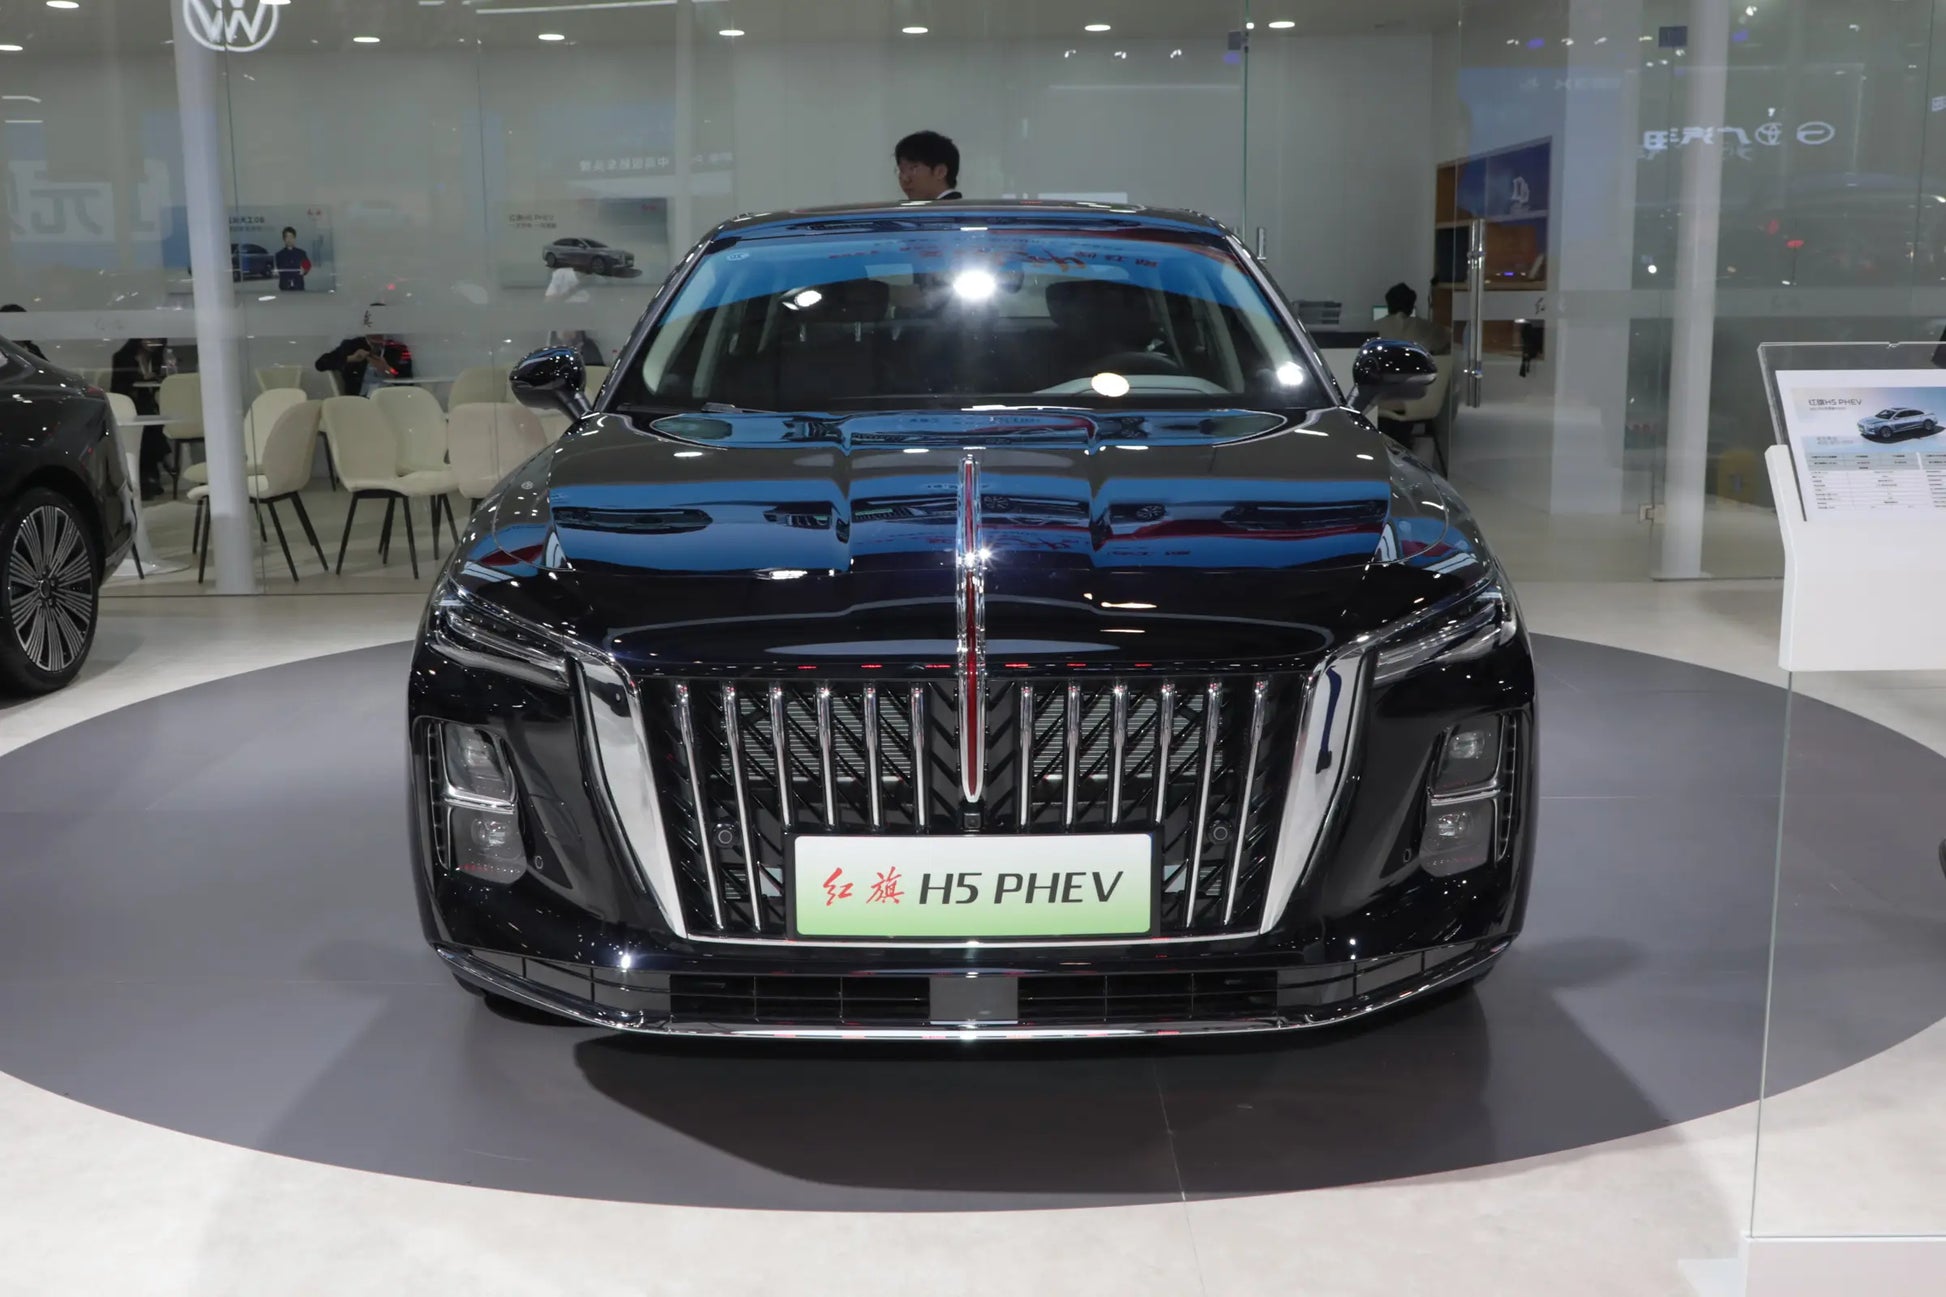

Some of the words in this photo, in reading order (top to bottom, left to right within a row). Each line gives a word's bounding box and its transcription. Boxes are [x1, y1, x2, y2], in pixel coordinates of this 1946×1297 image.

[1838, 398, 1863, 406] PHEV
[822, 866, 905, 906] 红旗
[919, 872, 983, 905] H5
[994, 871, 1124, 904] PHEV
